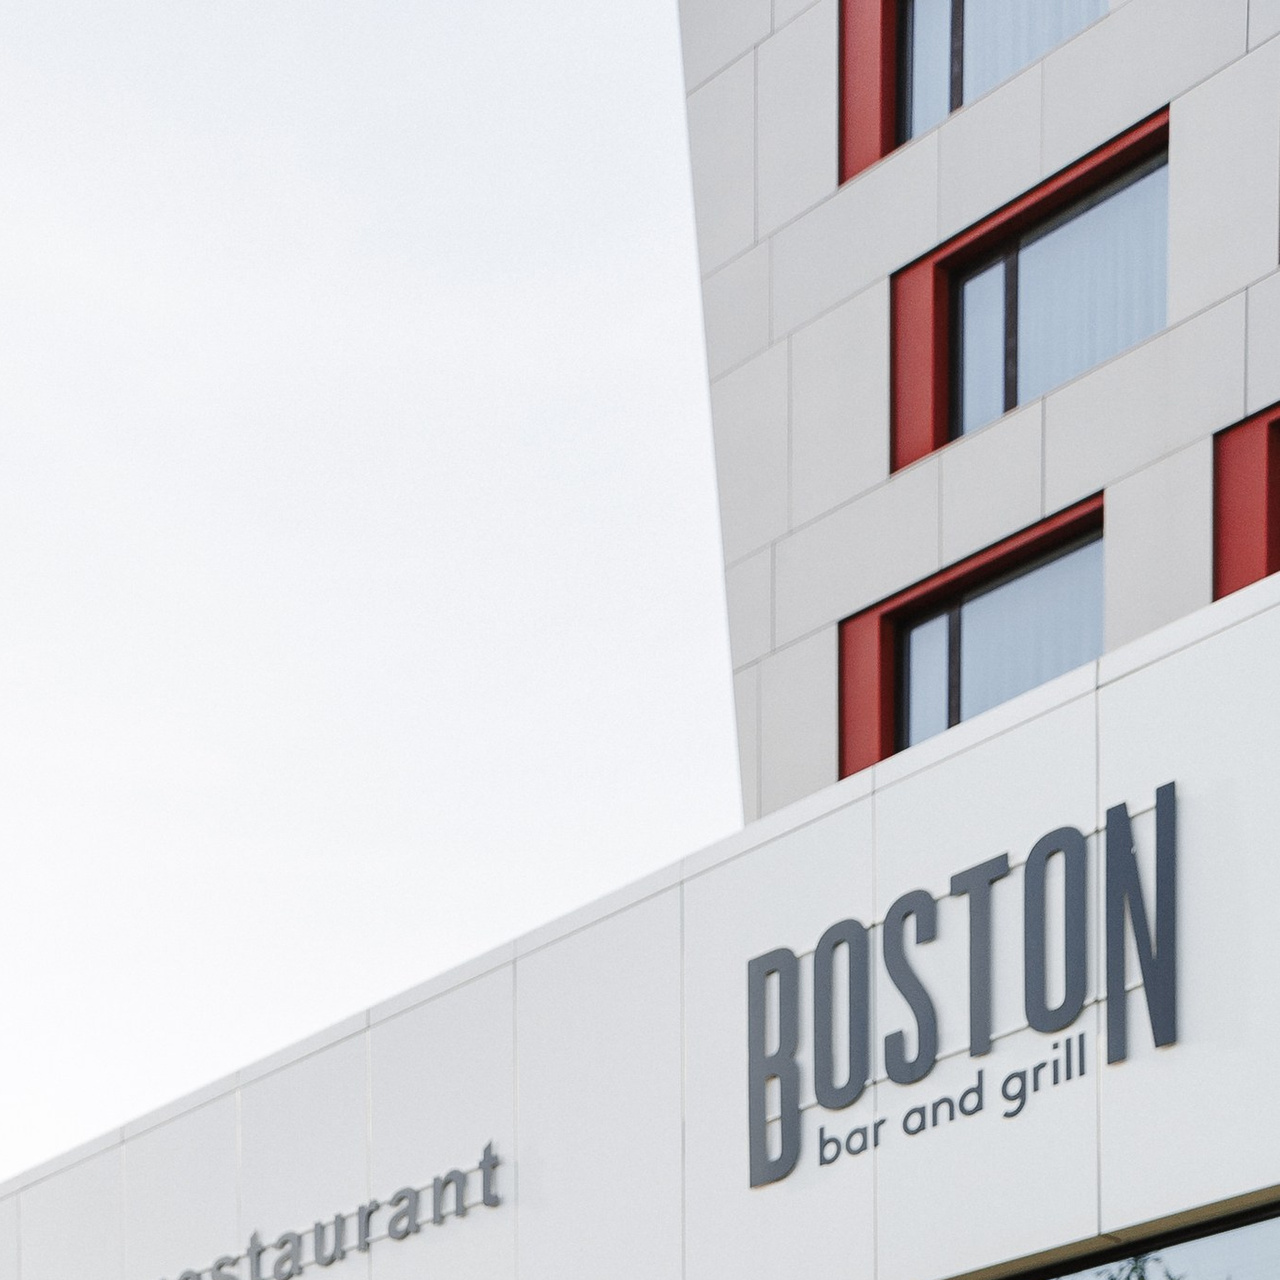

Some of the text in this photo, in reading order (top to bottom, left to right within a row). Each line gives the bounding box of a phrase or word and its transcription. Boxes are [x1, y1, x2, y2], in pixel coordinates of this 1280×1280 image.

[747, 780, 1177, 1189] BOSTON
[818, 1032, 1087, 1167] bar and grill
